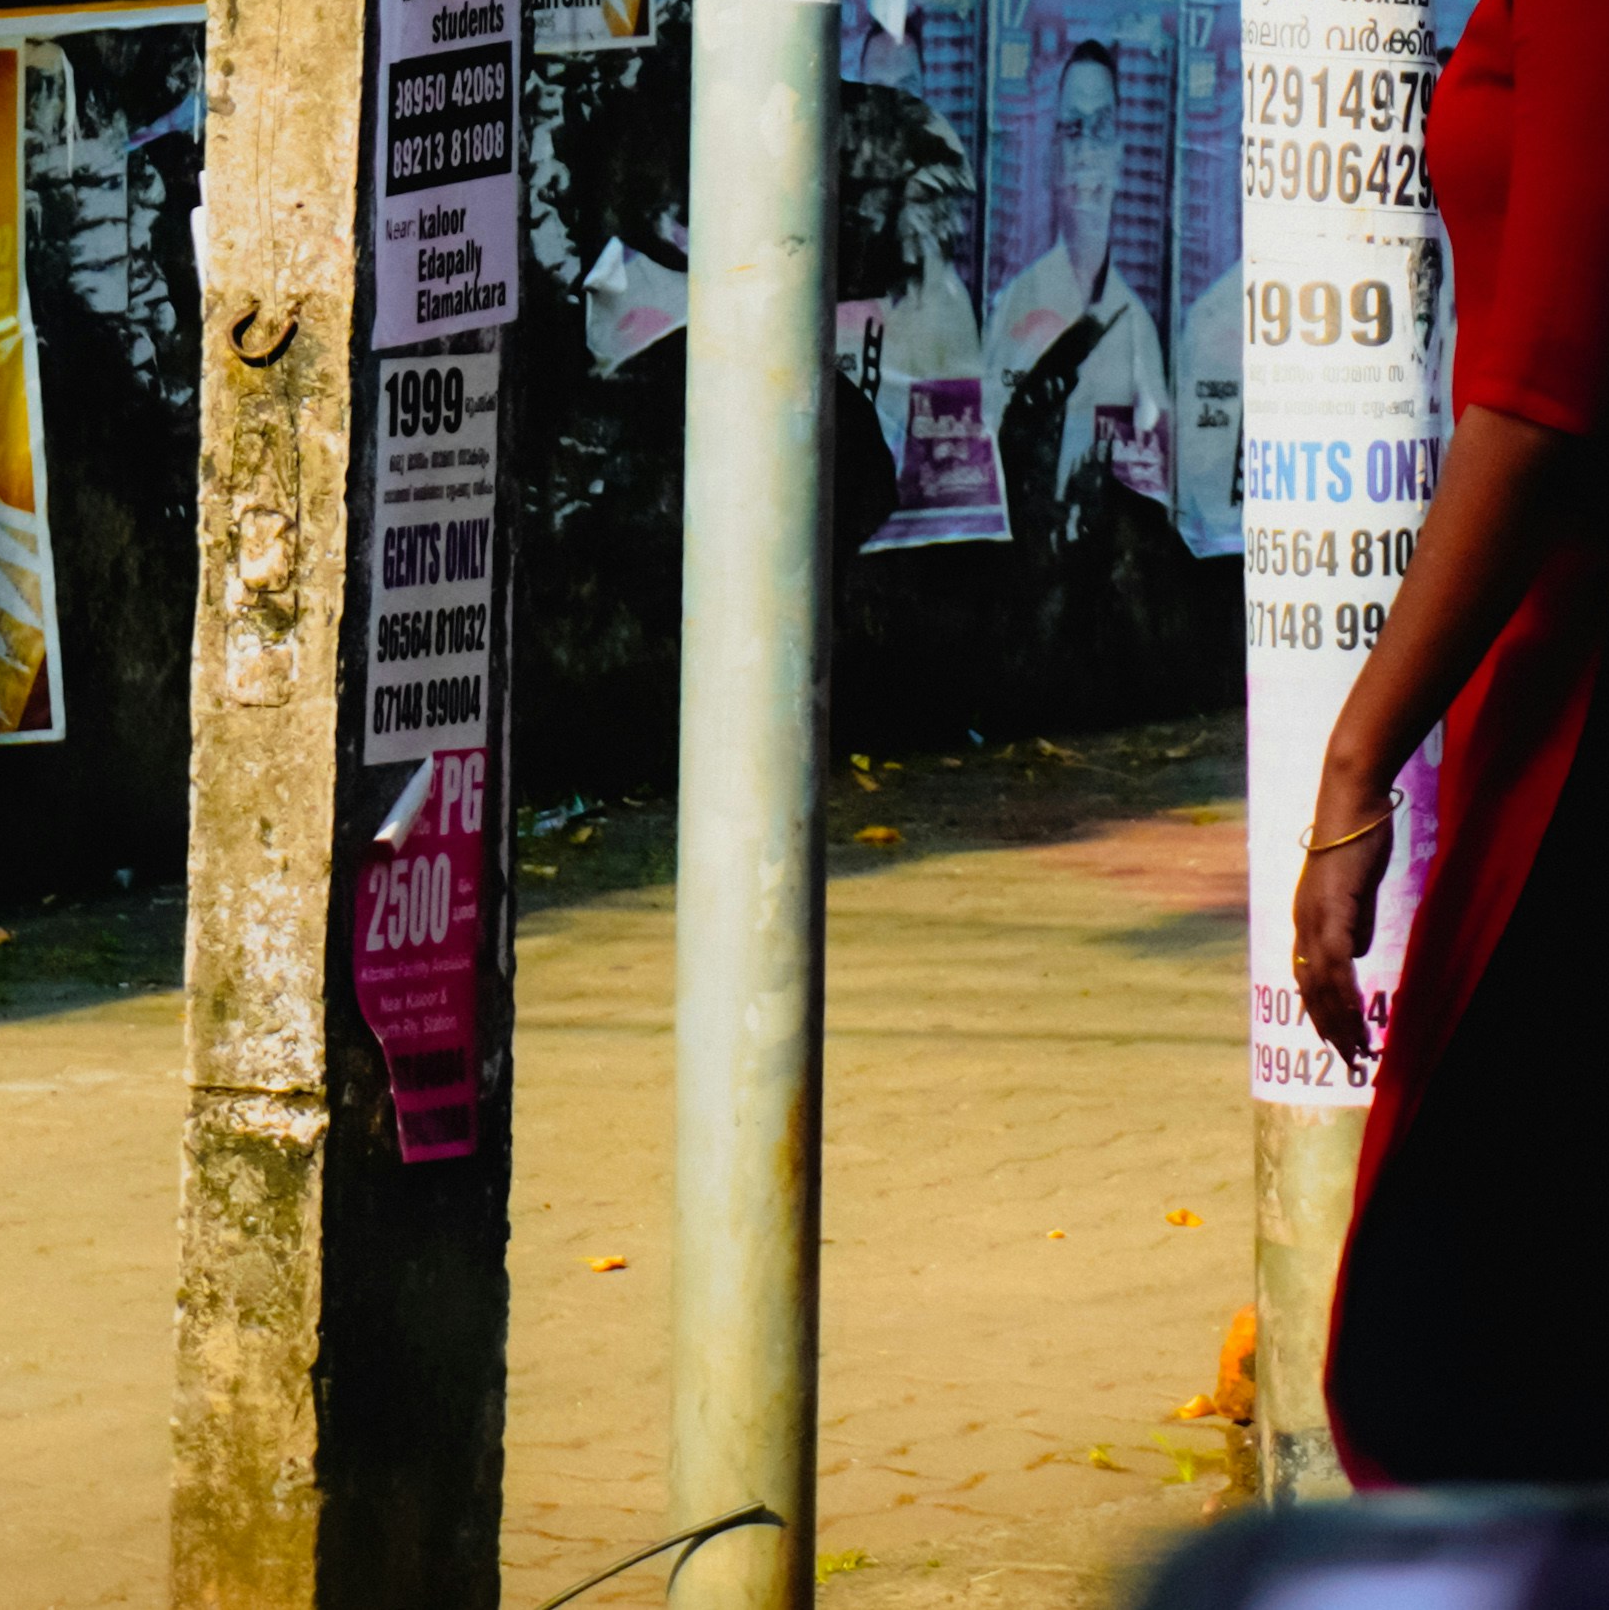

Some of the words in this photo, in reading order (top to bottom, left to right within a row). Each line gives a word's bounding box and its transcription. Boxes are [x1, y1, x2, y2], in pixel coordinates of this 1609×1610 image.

[451, 61, 505, 108] 42069
[393, 141, 445, 179] 89213
[450, 120, 505, 168] 81808
[418, 204, 466, 242] kaloor
[417, 240, 483, 282] Edapally
[417, 278, 507, 325] Elamakkara
[1246, 278, 1393, 347] 1999
[384, 366, 464, 438] 1999
[1249, 438, 1353, 503] GENTS
[383, 522, 442, 591] GENTS
[445, 517, 490, 583] ONLY
[1247, 527, 1339, 578] 96564
[377, 609, 433, 663] 96564
[435, 602, 487, 656] 81032
[373, 682, 423, 735] 87148
[426, 674, 481, 728] 99004
[439, 750, 485, 837] PG
[366, 851, 452, 952] 2500
